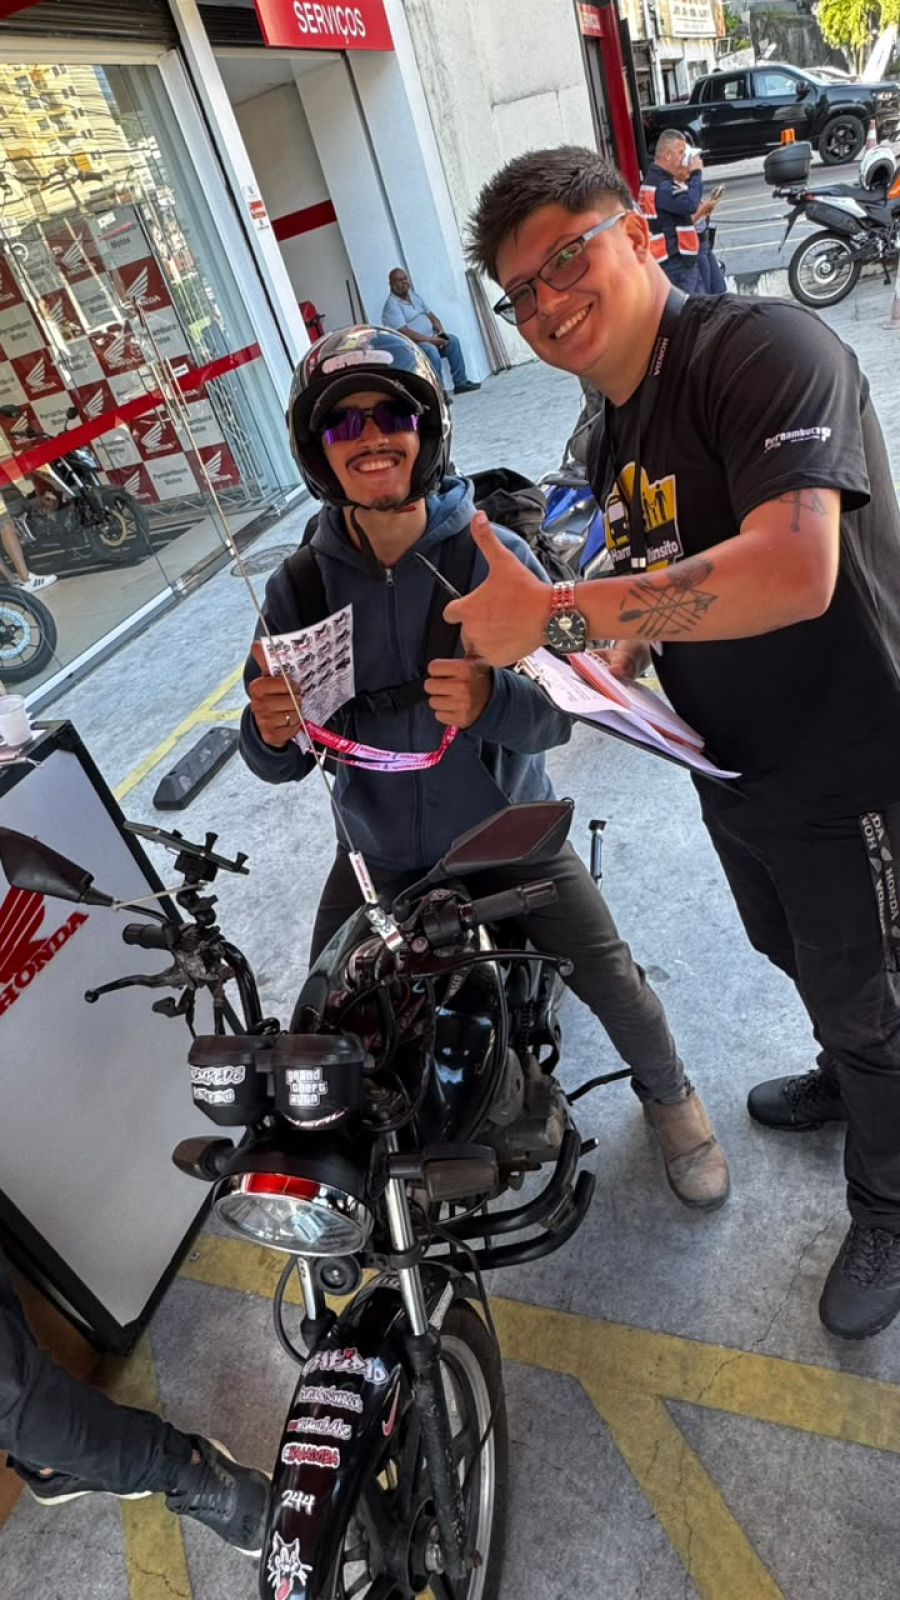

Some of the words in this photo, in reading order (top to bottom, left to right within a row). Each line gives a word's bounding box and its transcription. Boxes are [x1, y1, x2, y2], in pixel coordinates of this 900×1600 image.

[294, 1, 366, 45] SERVIÇOS
[653, 337, 670, 376] HONDA
[885, 866, 899, 922] HONDA
[0, 911, 90, 1015] HONDA
[281, 1489, 316, 1516] 244
